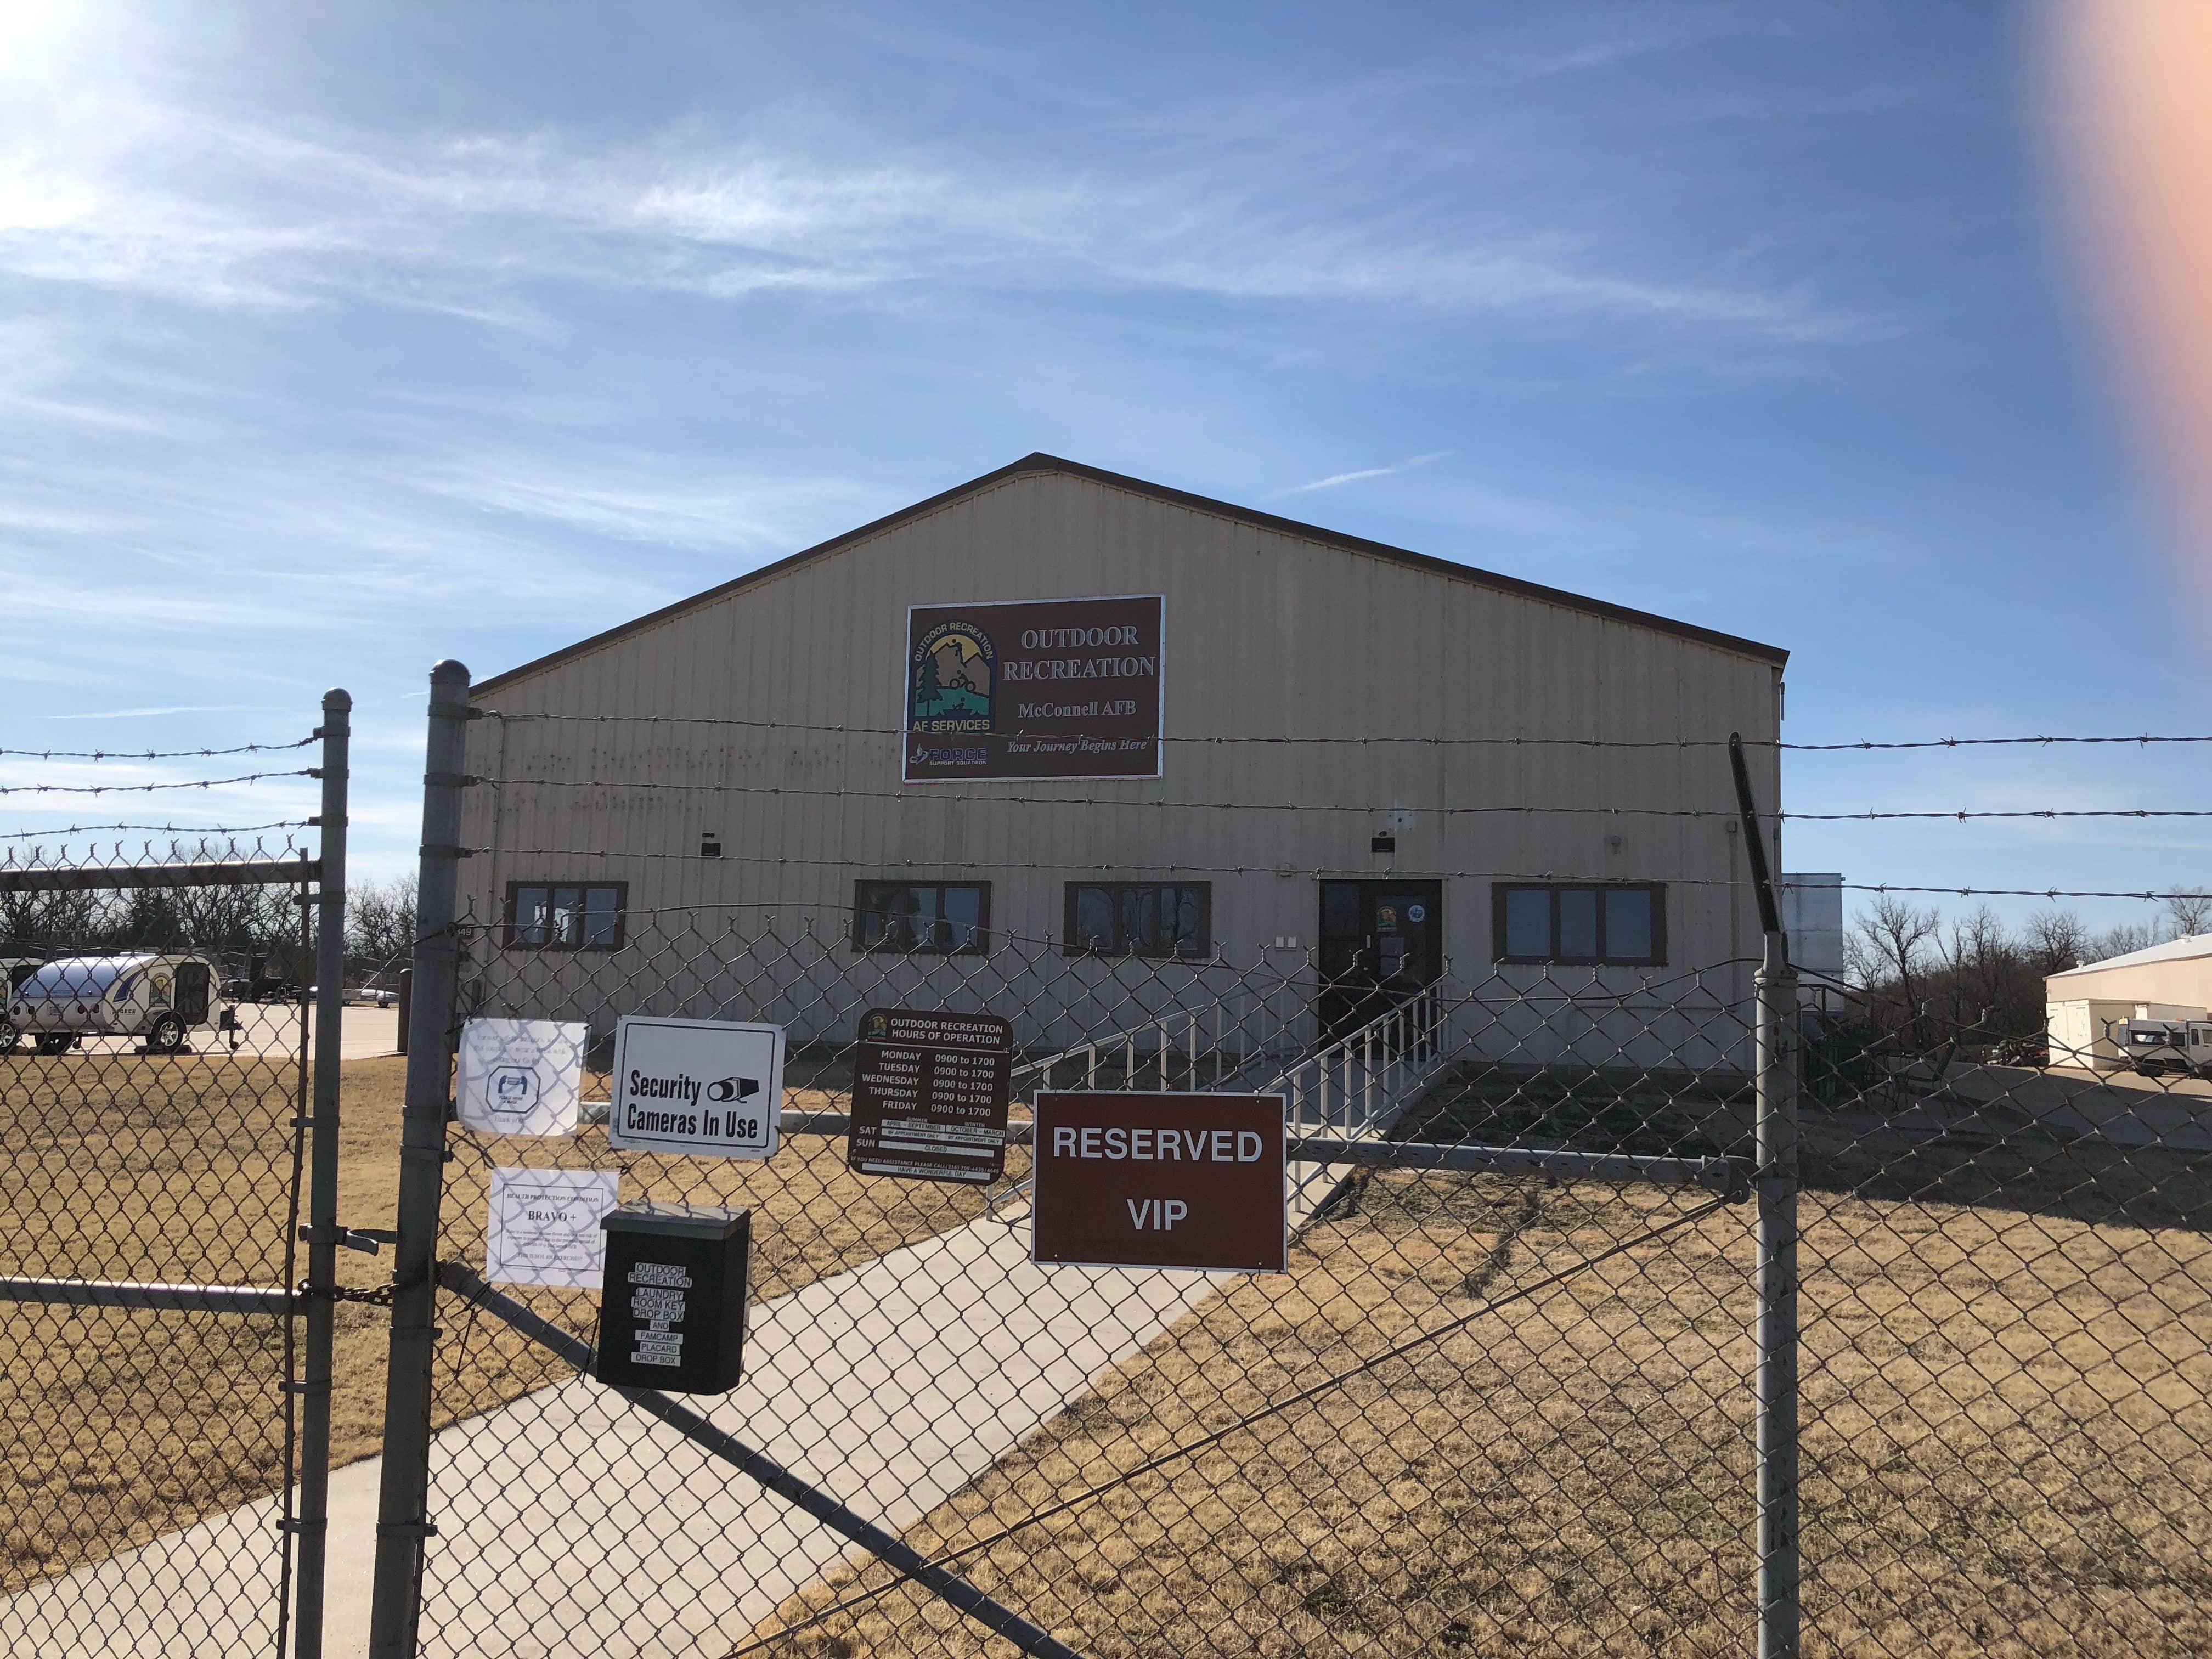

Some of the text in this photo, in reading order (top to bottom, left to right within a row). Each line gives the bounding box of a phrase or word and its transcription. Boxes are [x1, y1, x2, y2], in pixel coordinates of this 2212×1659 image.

[915, 622, 994, 662] OUTDOOR RECREATION
[1021, 626, 1139, 650] OUTDOOR
[1003, 657, 1155, 681] RECREATION
[1018, 700, 1137, 719] McConnell AFB
[913, 720, 990, 732] AF SERVICES
[1007, 740, 1147, 754] Your Journey Begins Here
[929, 748, 987, 761] FORCE
[891, 1018, 1003, 1034] OUTDOOR RECREATION
[892, 1029, 926, 1040] HOURS
[928, 1031, 941, 1040] OF
[943, 1033, 1000, 1045] OPERATION
[881, 1050, 995, 1066] MONDAY 0900 to 1700
[878, 1062, 994, 1079] TUESDAY 0900 to 1700
[630, 1069, 702, 1106] Security
[862, 1074, 993, 1091] WEDNESDAY 0900 to 1700
[868, 1086, 992, 1104] THURSDAY 0900 to 1700
[882, 1100, 991, 1116] FRIDAY 0900 to 1700
[627, 1103, 697, 1135] Cameras
[703, 1109, 720, 1136] In
[725, 1111, 758, 1139] Use
[908, 1122, 940, 1130] SEPTEMBER
[859, 1126, 877, 1135] SAT
[856, 1138, 875, 1148] SUN
[1053, 1127, 1262, 1162] RESERVED
[883, 1158, 913, 1166] ASSISTANCE
[527, 1210, 567, 1222] BRAVO
[1127, 1199, 1187, 1231] VIP
[637, 1263, 684, 1277] OUTDOOR
[629, 1273, 691, 1286] RECREATION
[637, 1288, 682, 1300] LAUNDRY
[634, 1298, 685, 1311] ROOM KEY
[634, 1308, 682, 1321] DROP BOX
[641, 1332, 678, 1342] FAMCAMP
[641, 1343, 677, 1353] PLACARD
[636, 1353, 676, 1365] DROP BOX
